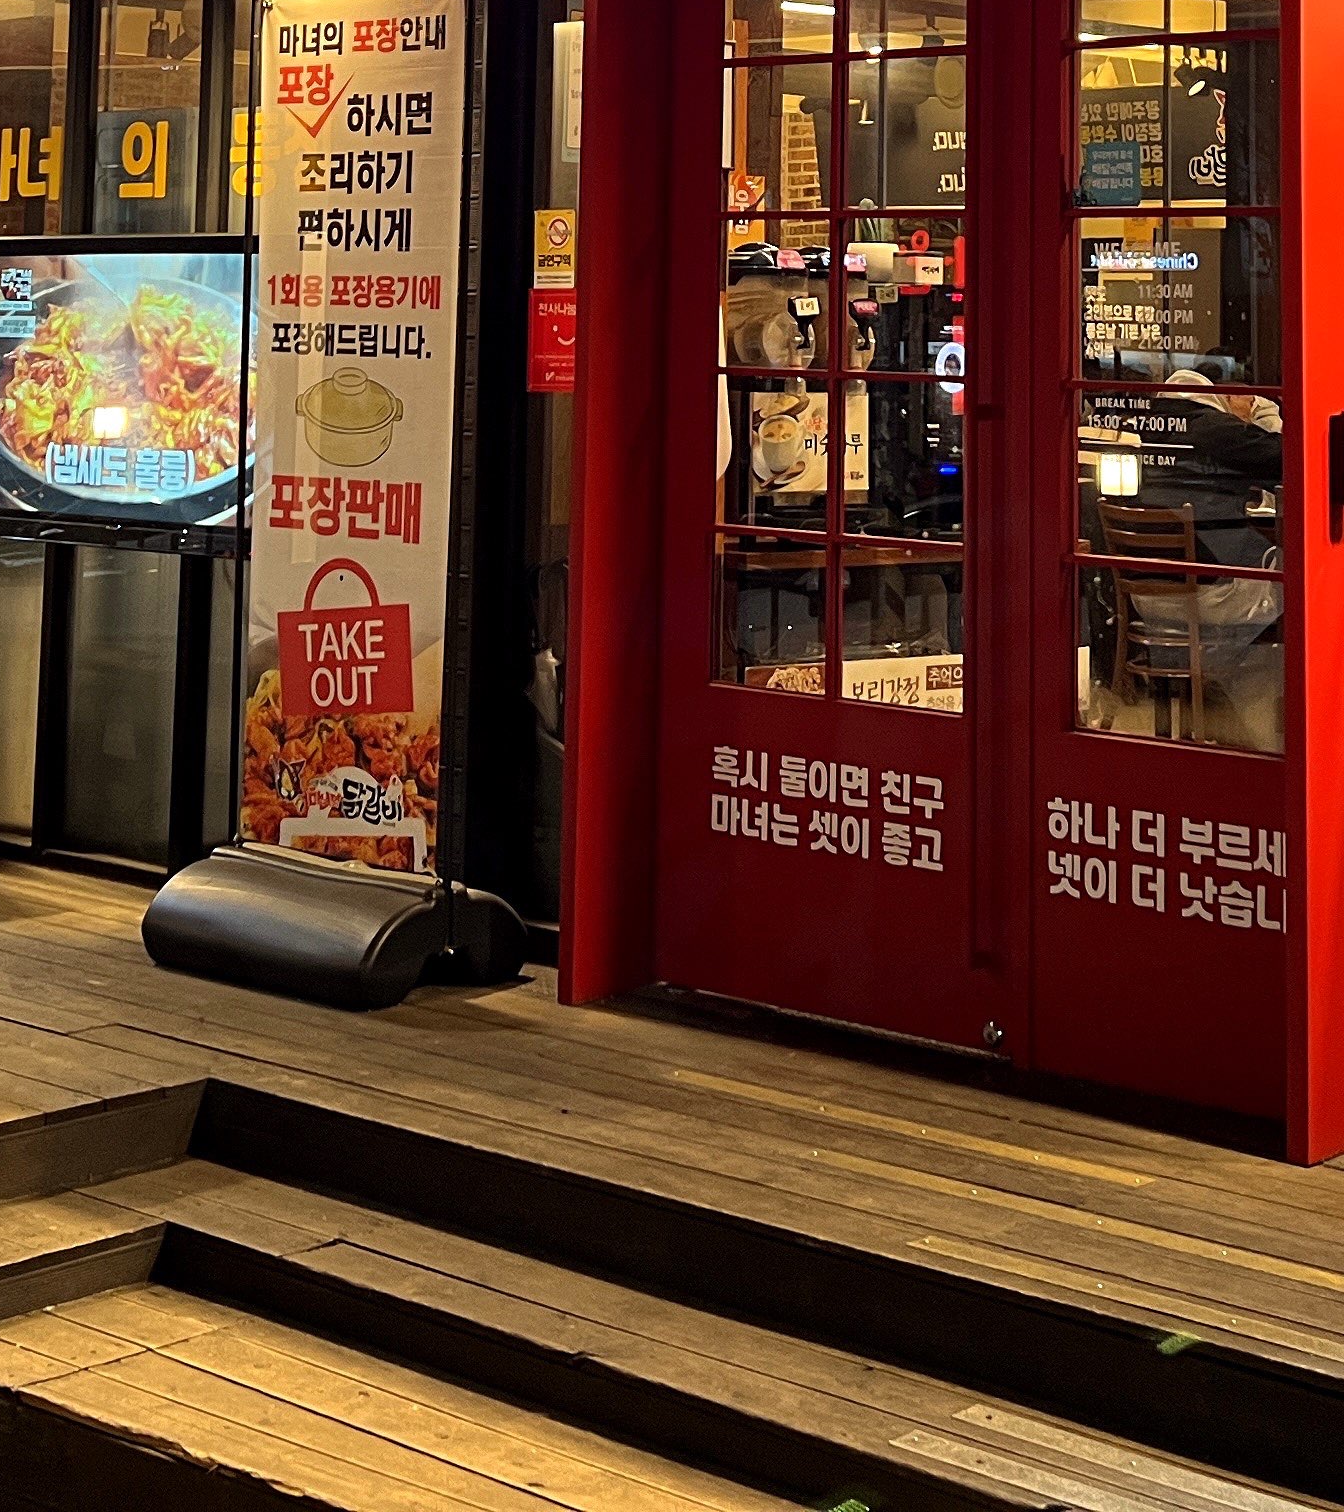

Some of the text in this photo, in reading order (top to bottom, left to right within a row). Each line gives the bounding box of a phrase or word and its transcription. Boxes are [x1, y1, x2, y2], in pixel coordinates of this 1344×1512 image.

[278, 15, 448, 57] 마녀의 포장안내
[277, 64, 434, 138] 포장 하시면
[300, 151, 414, 194] 조리하기
[297, 209, 413, 252] 편하시게
[267, 275, 442, 310] 1회용 포장용기에
[1138, 284, 1193, 299] 11:30 AM
[1174, 309, 1194, 324] PM
[1174, 335, 1193, 350] PM
[1087, 414, 1120, 429] 15:00
[1132, 416, 1165, 431] 17:00
[1168, 417, 1187, 432] PM
[1096, 397, 1150, 410] BREAK TIME
[45, 441, 196, 492] (냄새도 훌륭)
[1158, 455, 1176, 466] DAY
[269, 474, 422, 545] 포장판매
[298, 619, 386, 664] TAKE
[310, 665, 379, 708] OUT
[343, 778, 402, 825] 닭갈비
[712, 745, 945, 819] 혹시 둘이면 친구
[712, 793, 944, 872] 마녀는 셋이 좋고
[1048, 796, 1121, 850] 하나
[1130, 808, 1167, 857] 더
[1048, 850, 1117, 905] 넷이
[1130, 863, 1167, 913] 더
